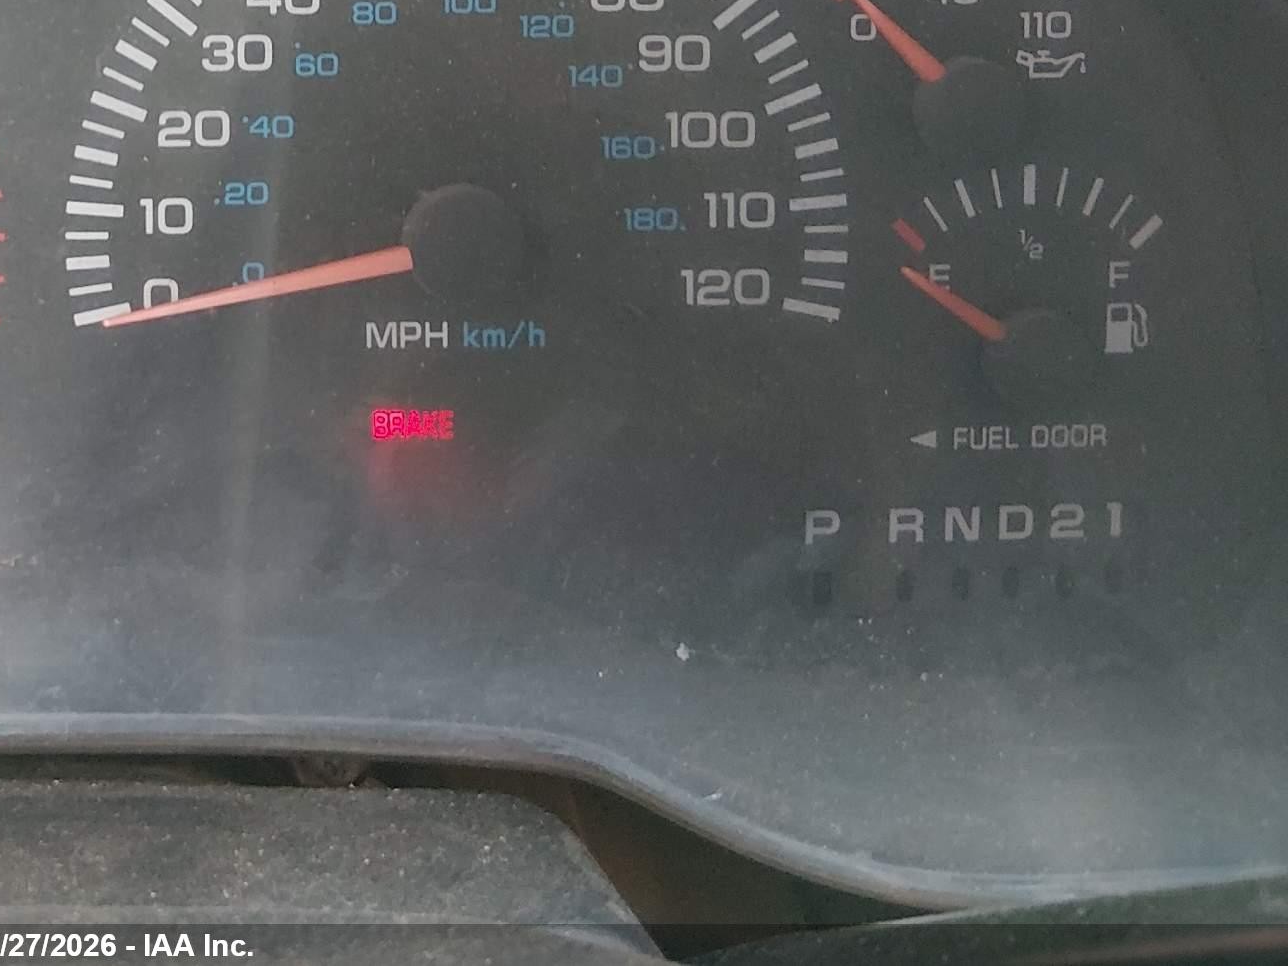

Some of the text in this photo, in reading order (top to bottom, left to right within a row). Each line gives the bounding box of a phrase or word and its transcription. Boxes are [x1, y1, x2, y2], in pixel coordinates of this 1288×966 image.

[352, 0, 397, 25] 80
[1021, 12, 1071, 38] 110
[520, 15, 574, 38] 120
[850, 14, 877, 40] 0
[202, 36, 272, 72] 30
[295, 53, 338, 77] 60
[638, 36, 710, 72] 90
[569, 64, 623, 88] 140
[158, 111, 229, 147] 20
[250, 115, 294, 138] 40
[666, 112, 755, 148] 100
[602, 136, 655, 159] 160
[224, 182, 268, 205] 20
[140, 198, 192, 234] 10
[624, 208, 676, 230] 180
[703, 193, 775, 228] 110
[242, 263, 264, 285] 0
[929, 265, 950, 289] E
[1110, 263, 1130, 288] F
[143, 280, 179, 309] 0
[682, 270, 770, 306] 120
[366, 322, 546, 348] MPH km/h
[372, 410, 454, 440] BRAKE
[955, 426, 1107, 449] FUEL DOOR
